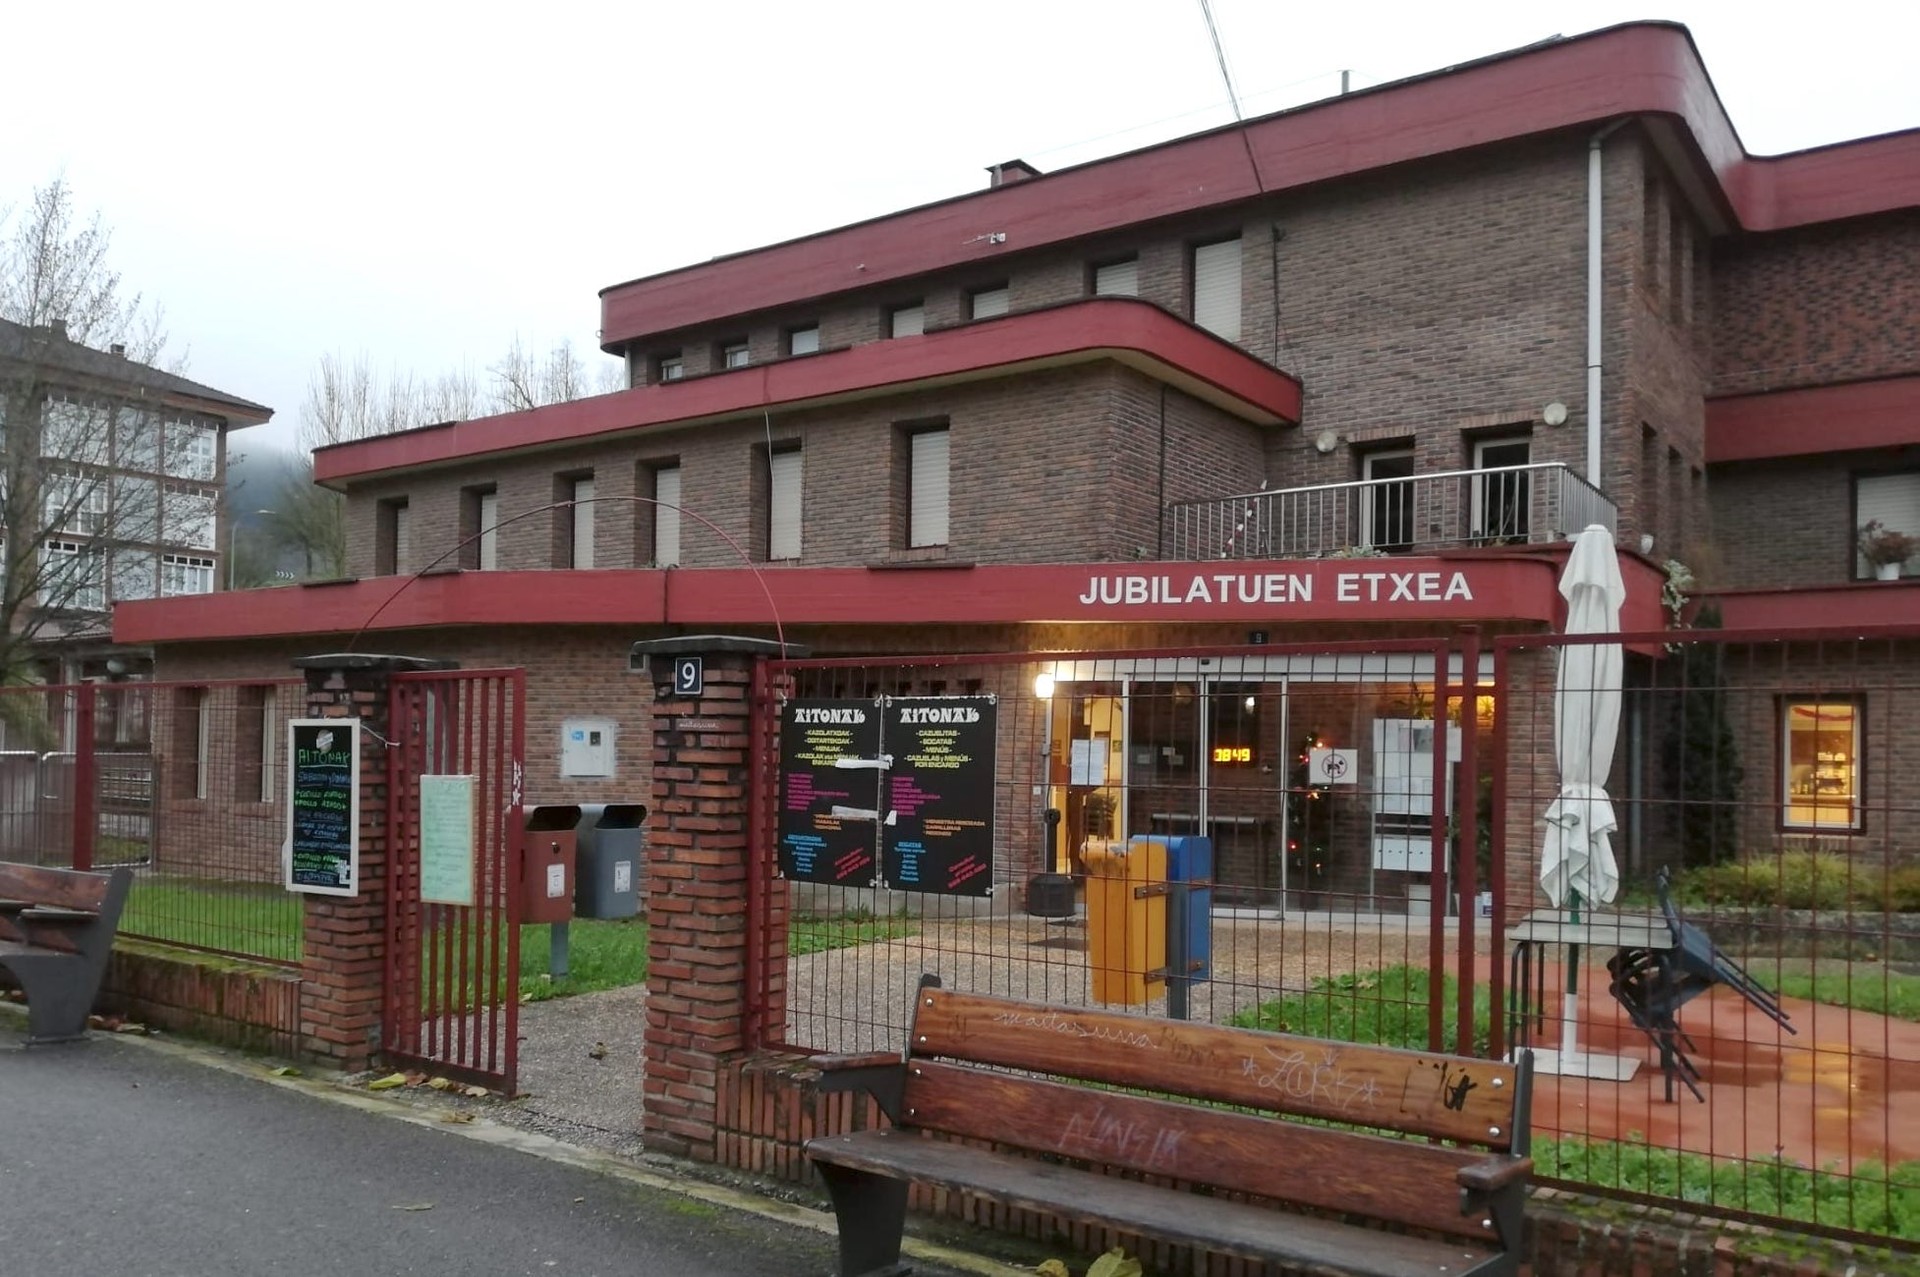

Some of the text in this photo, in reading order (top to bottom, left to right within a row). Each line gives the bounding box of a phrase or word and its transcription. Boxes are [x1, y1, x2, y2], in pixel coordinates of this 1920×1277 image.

[1080, 572, 1473, 605] JUBILATUEN ETXEA
[682, 663, 695, 689] 9
